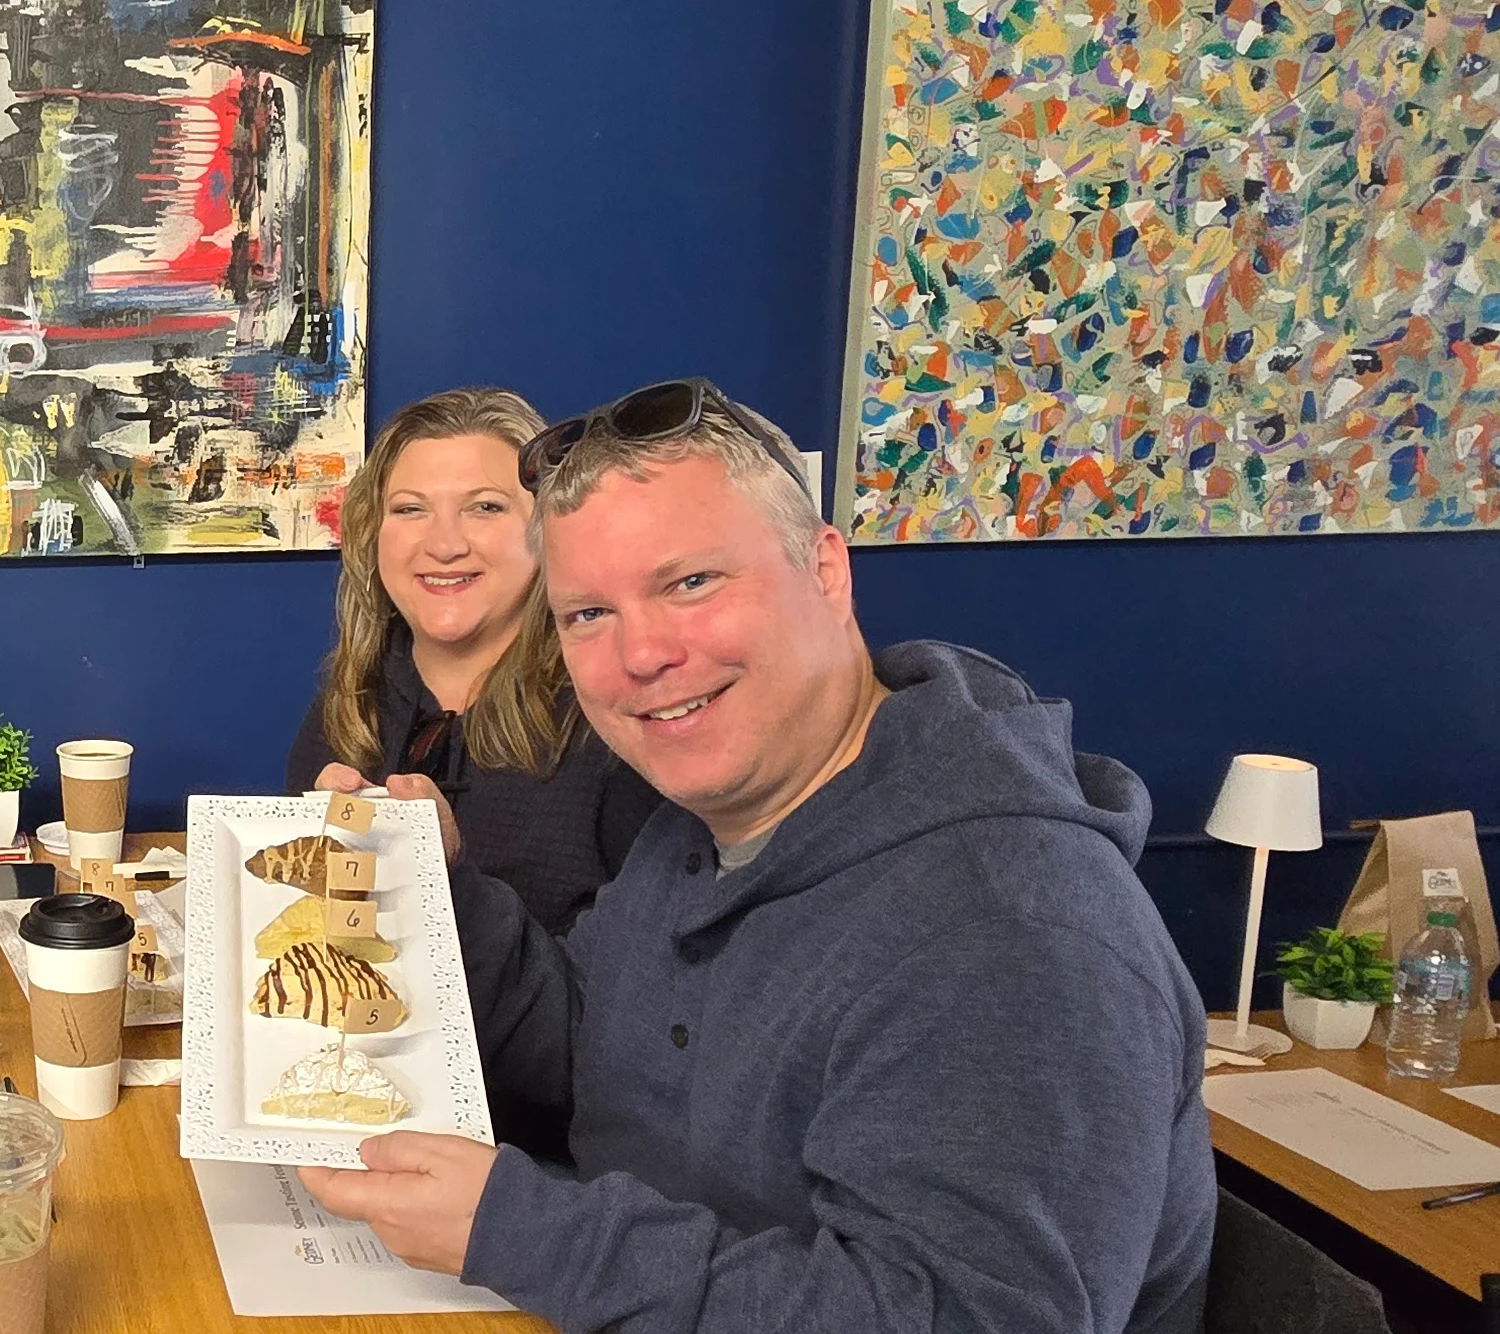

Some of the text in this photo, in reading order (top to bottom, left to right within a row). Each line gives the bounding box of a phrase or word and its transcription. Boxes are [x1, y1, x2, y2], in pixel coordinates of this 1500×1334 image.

[340, 802, 355, 821] 8
[92, 862, 100, 876] 8
[346, 860, 358, 877] 7
[105, 880, 114, 892] 7
[346, 908, 361, 927] 6
[138, 932, 147, 947] 5
[366, 1008, 379, 1025] 5
